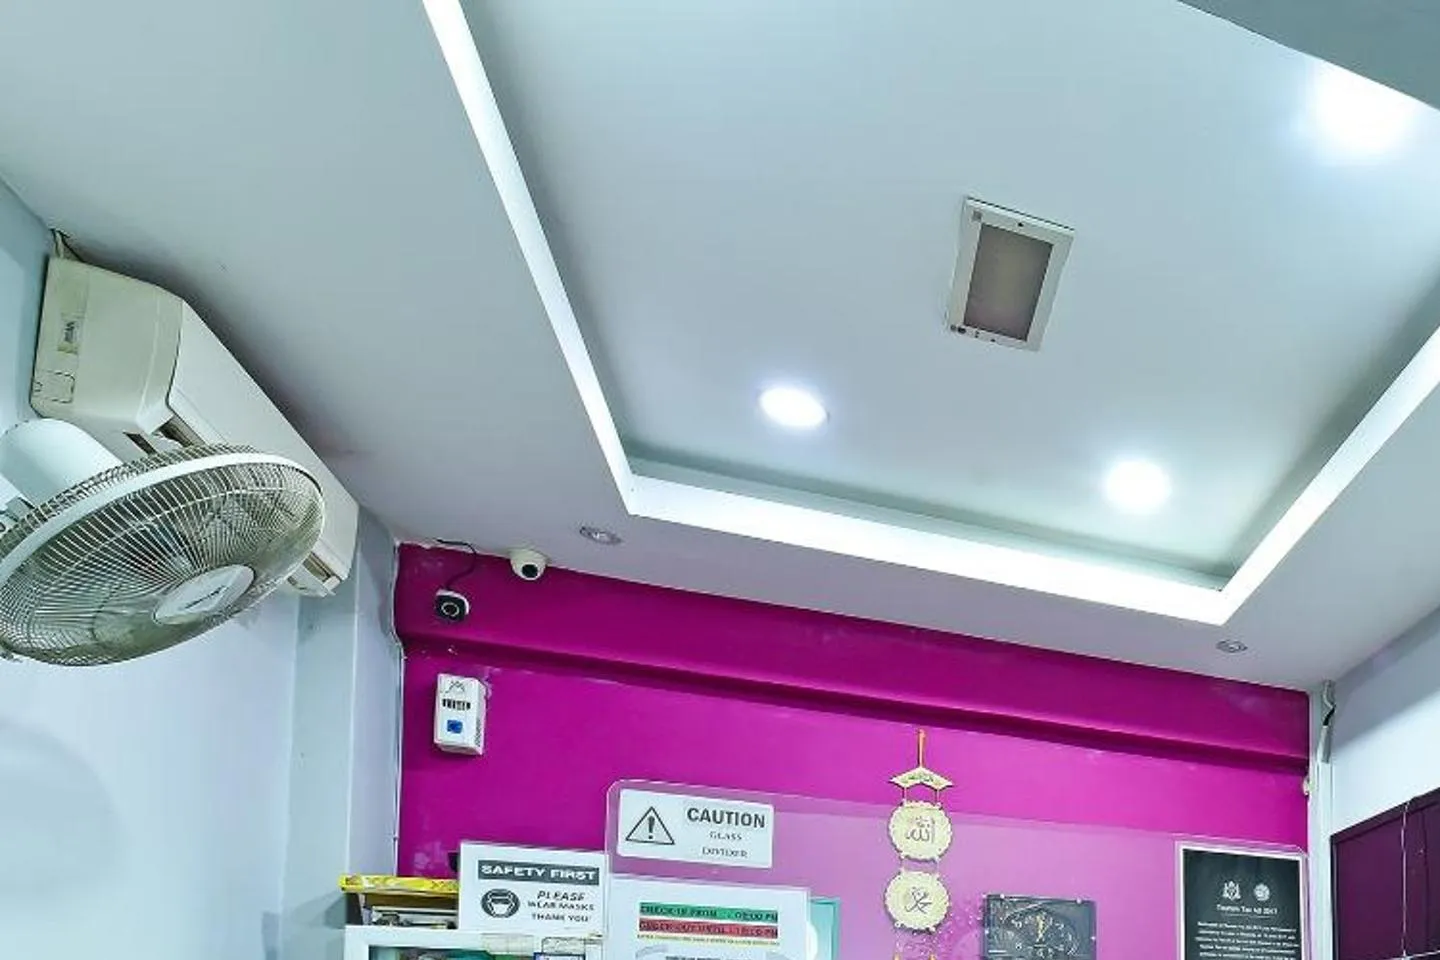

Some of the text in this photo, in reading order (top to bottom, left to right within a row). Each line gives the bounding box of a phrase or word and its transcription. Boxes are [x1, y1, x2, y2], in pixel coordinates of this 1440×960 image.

[687, 807, 765, 828] CAUTION
[709, 831, 742, 840] GLASS
[481, 864, 597, 880] SAFETY FIRST
[536, 890, 586, 901] PLEASE
[559, 902, 595, 911] MASKS
